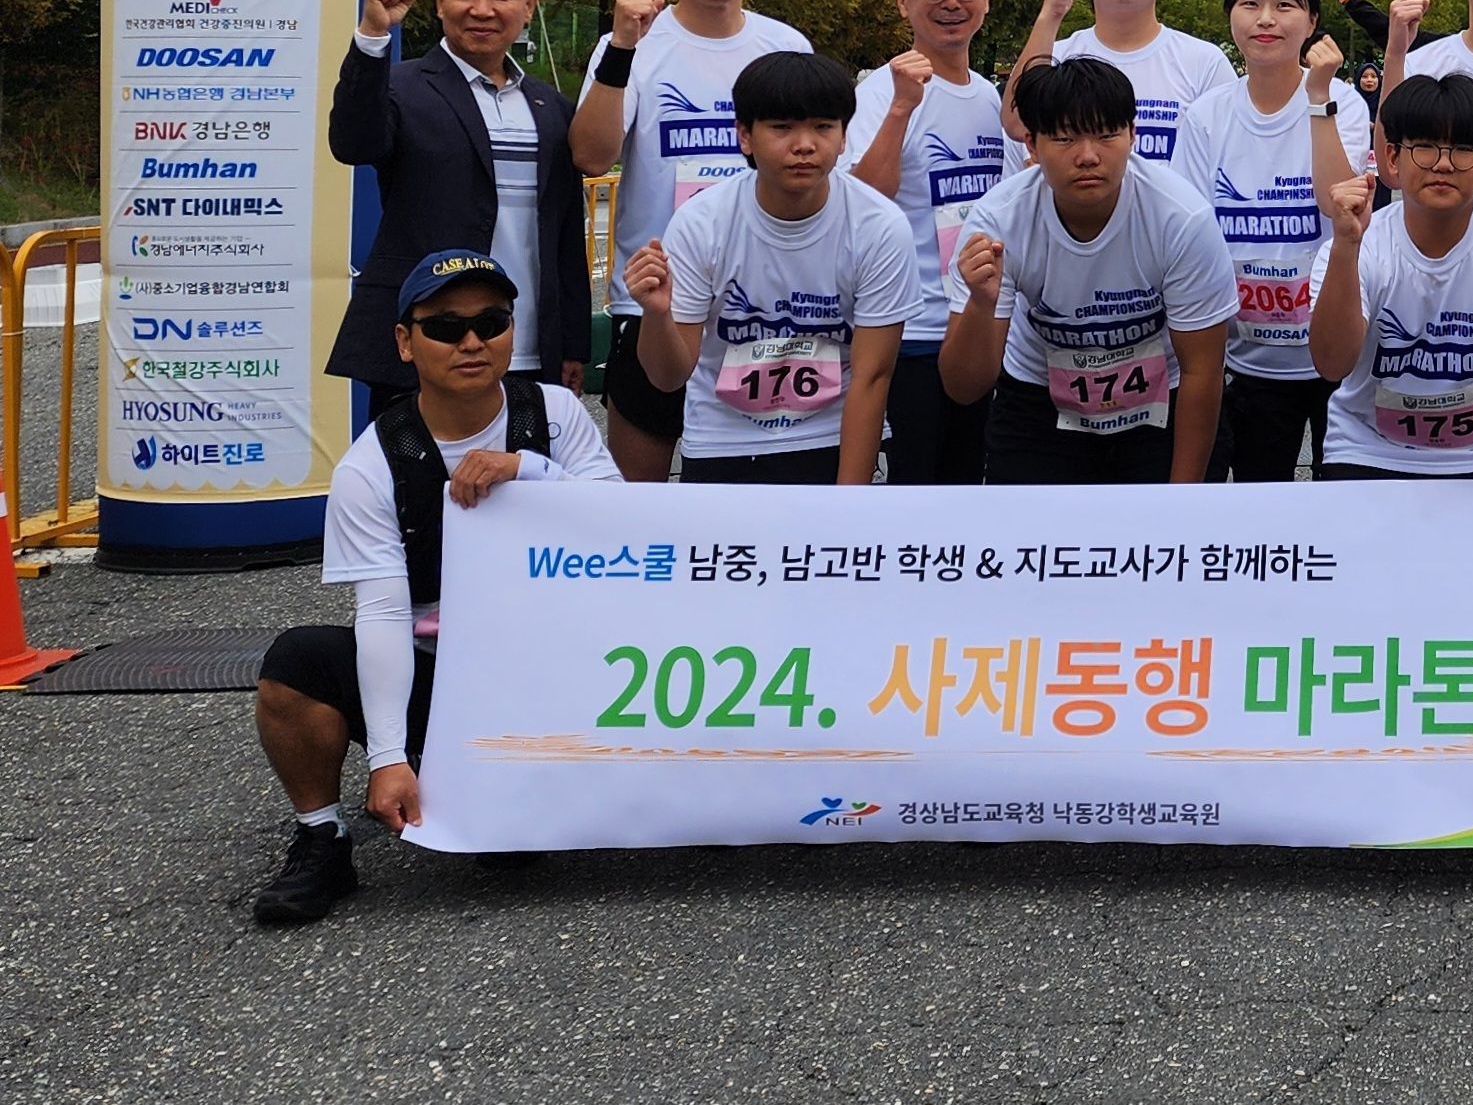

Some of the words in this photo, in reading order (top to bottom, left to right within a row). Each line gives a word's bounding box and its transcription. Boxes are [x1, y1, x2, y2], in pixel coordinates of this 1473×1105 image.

[200, 19, 265, 30] 건강증진의원
[276, 20, 298, 31] 경남
[136, 47, 276, 67] DOOSAN
[230, 87, 295, 101] 경남본부
[135, 122, 187, 140] BNK
[192, 121, 271, 140] 경남은행
[669, 127, 738, 149] MARAT
[141, 158, 257, 178] Bumhan
[133, 198, 176, 216] SNT
[182, 197, 283, 216] 다이내믹스
[150, 244, 264, 256] 경남에너지주식회사
[1242, 264, 1298, 278] Bumhan
[1075, 295, 1161, 319] CHAMPIONSHIP
[1238, 281, 1311, 313] 2064
[132, 318, 193, 340] DN
[197, 321, 263, 338] 솔루션즈
[1035, 318, 1157, 346] MARATHON
[142, 359, 279, 379] 한국철강주식회사
[740, 365, 819, 400] 176
[1070, 365, 1150, 403] 174
[122, 400, 225, 422] HYOSUNG
[227, 402, 257, 410] HEAVY
[227, 411, 283, 421] INDUSTRIES
[1080, 410, 1150, 430] Bumhan
[161, 443, 265, 465] 하이트진로
[528, 544, 677, 582] Wee스쿨
[688, 544, 768, 587] 남중,
[781, 544, 882, 582] 남고반
[897, 543, 965, 582] 학생
[976, 548, 1004, 580] &
[1015, 543, 1190, 583] 지도교사가
[1200, 543, 1338, 583] 함께하는
[596, 646, 838, 730] 2024.
[868, 636, 1213, 737] 사제동행
[826, 817, 863, 826] NEI
[899, 802, 1045, 825] 경상남도교육청
[1053, 802, 1220, 826] 낙동강학생교육원
